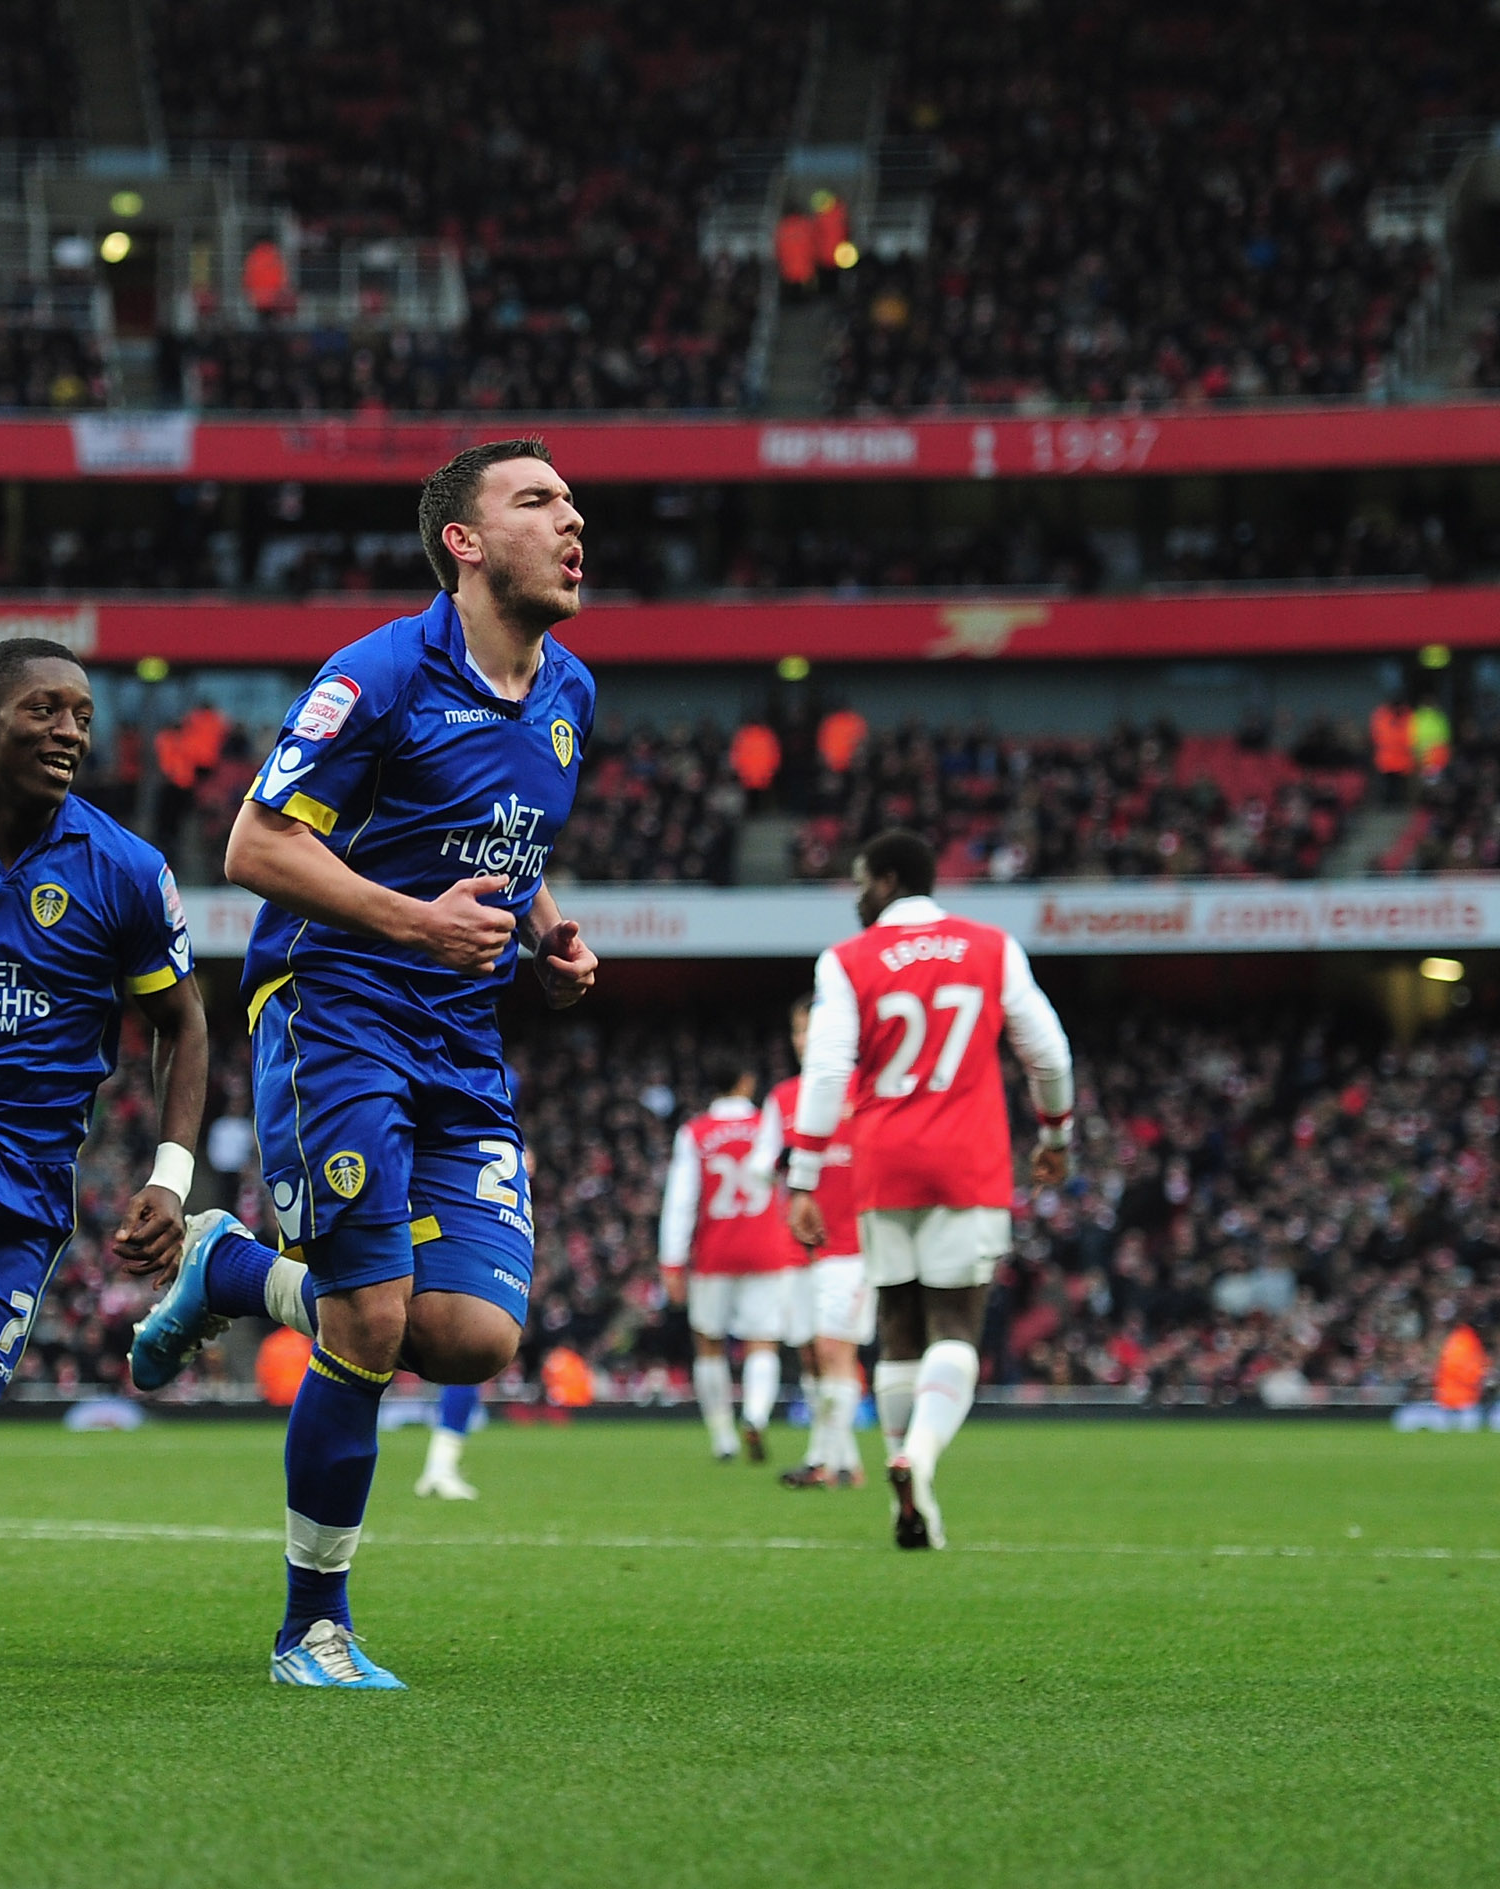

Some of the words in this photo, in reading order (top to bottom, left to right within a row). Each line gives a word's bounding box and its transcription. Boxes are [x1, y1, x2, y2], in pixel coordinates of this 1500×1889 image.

[489, 793, 545, 841] NET
[440, 829, 549, 878] FLIGHTS
[880, 935, 969, 972] EBOUE
[874, 984, 984, 1099] 27
